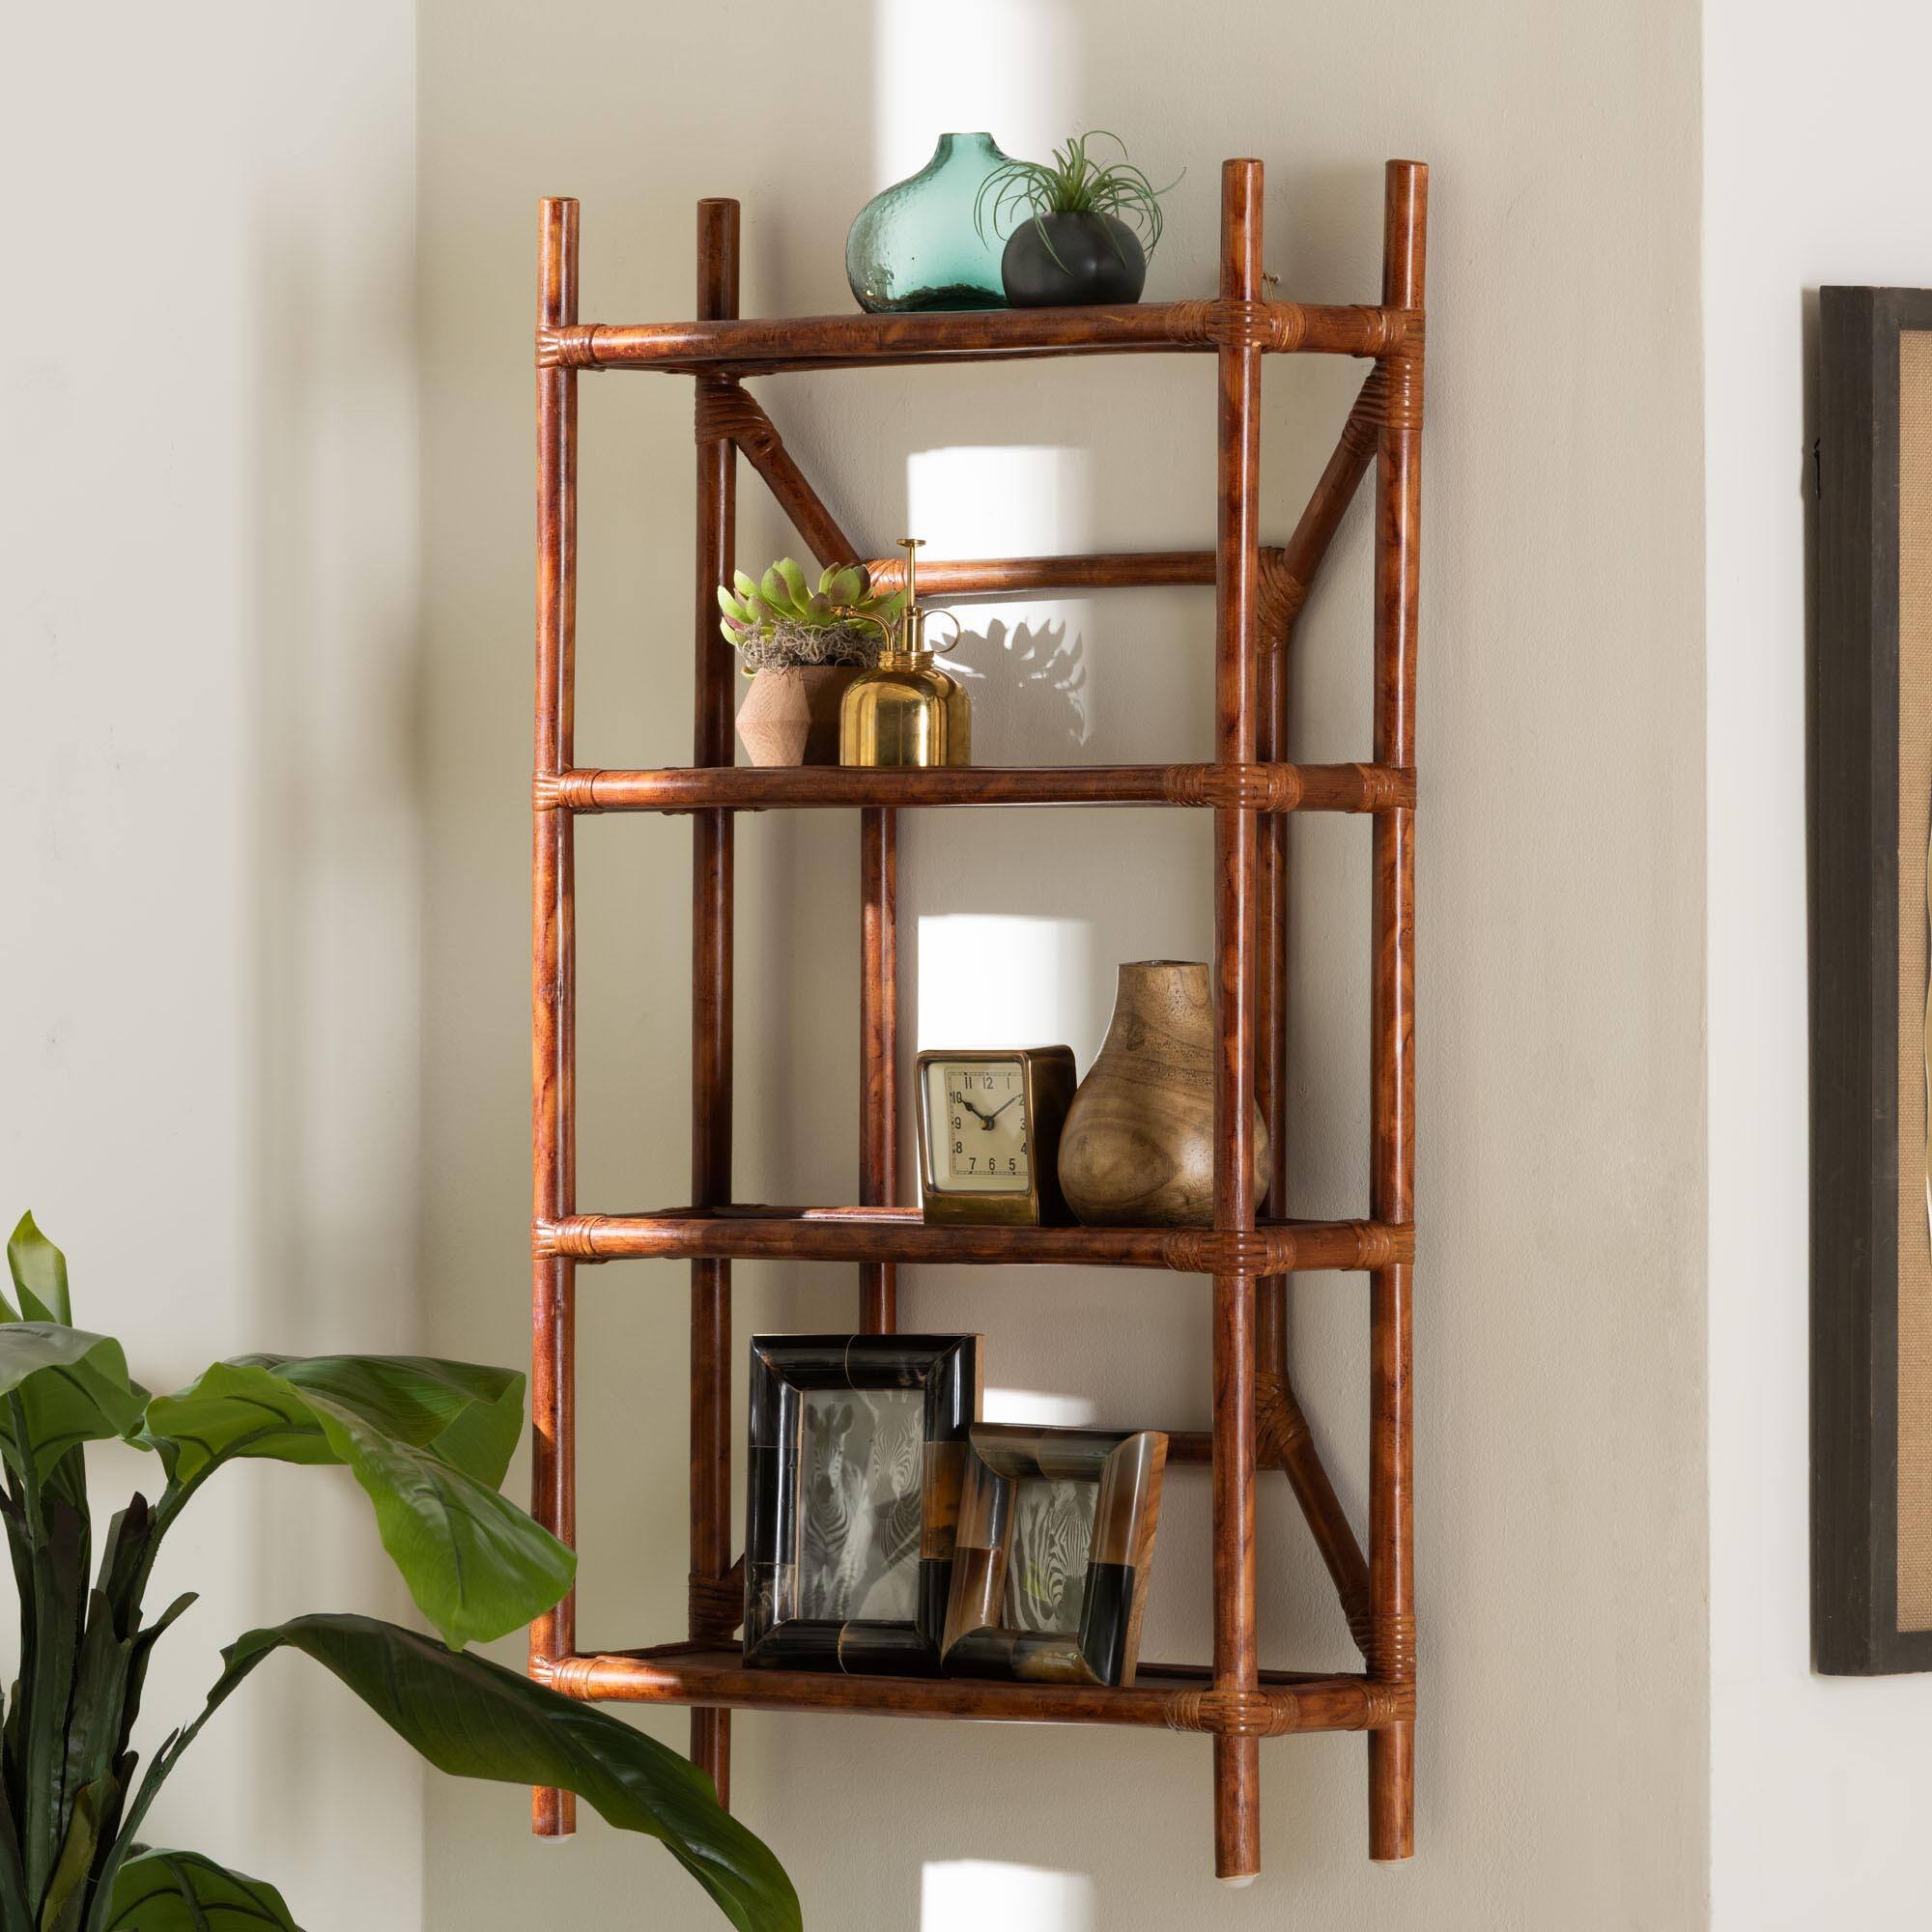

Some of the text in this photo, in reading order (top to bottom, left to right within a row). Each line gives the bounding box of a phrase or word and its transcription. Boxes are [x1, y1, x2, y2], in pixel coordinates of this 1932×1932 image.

[965, 1077, 972, 1090] 11
[983, 1077, 994, 1090] 12
[1007, 1077, 1010, 1090] 1
[952, 1091, 962, 1103] 10
[1018, 1094, 1024, 1106] 2
[954, 1117, 961, 1129] 9
[1020, 1118, 1026, 1130] 3
[955, 1142, 962, 1153] 8
[1020, 1143, 1027, 1155] 4
[969, 1158, 977, 1170] 7
[989, 1158, 996, 1171] 6
[1009, 1158, 1015, 1171] 5
